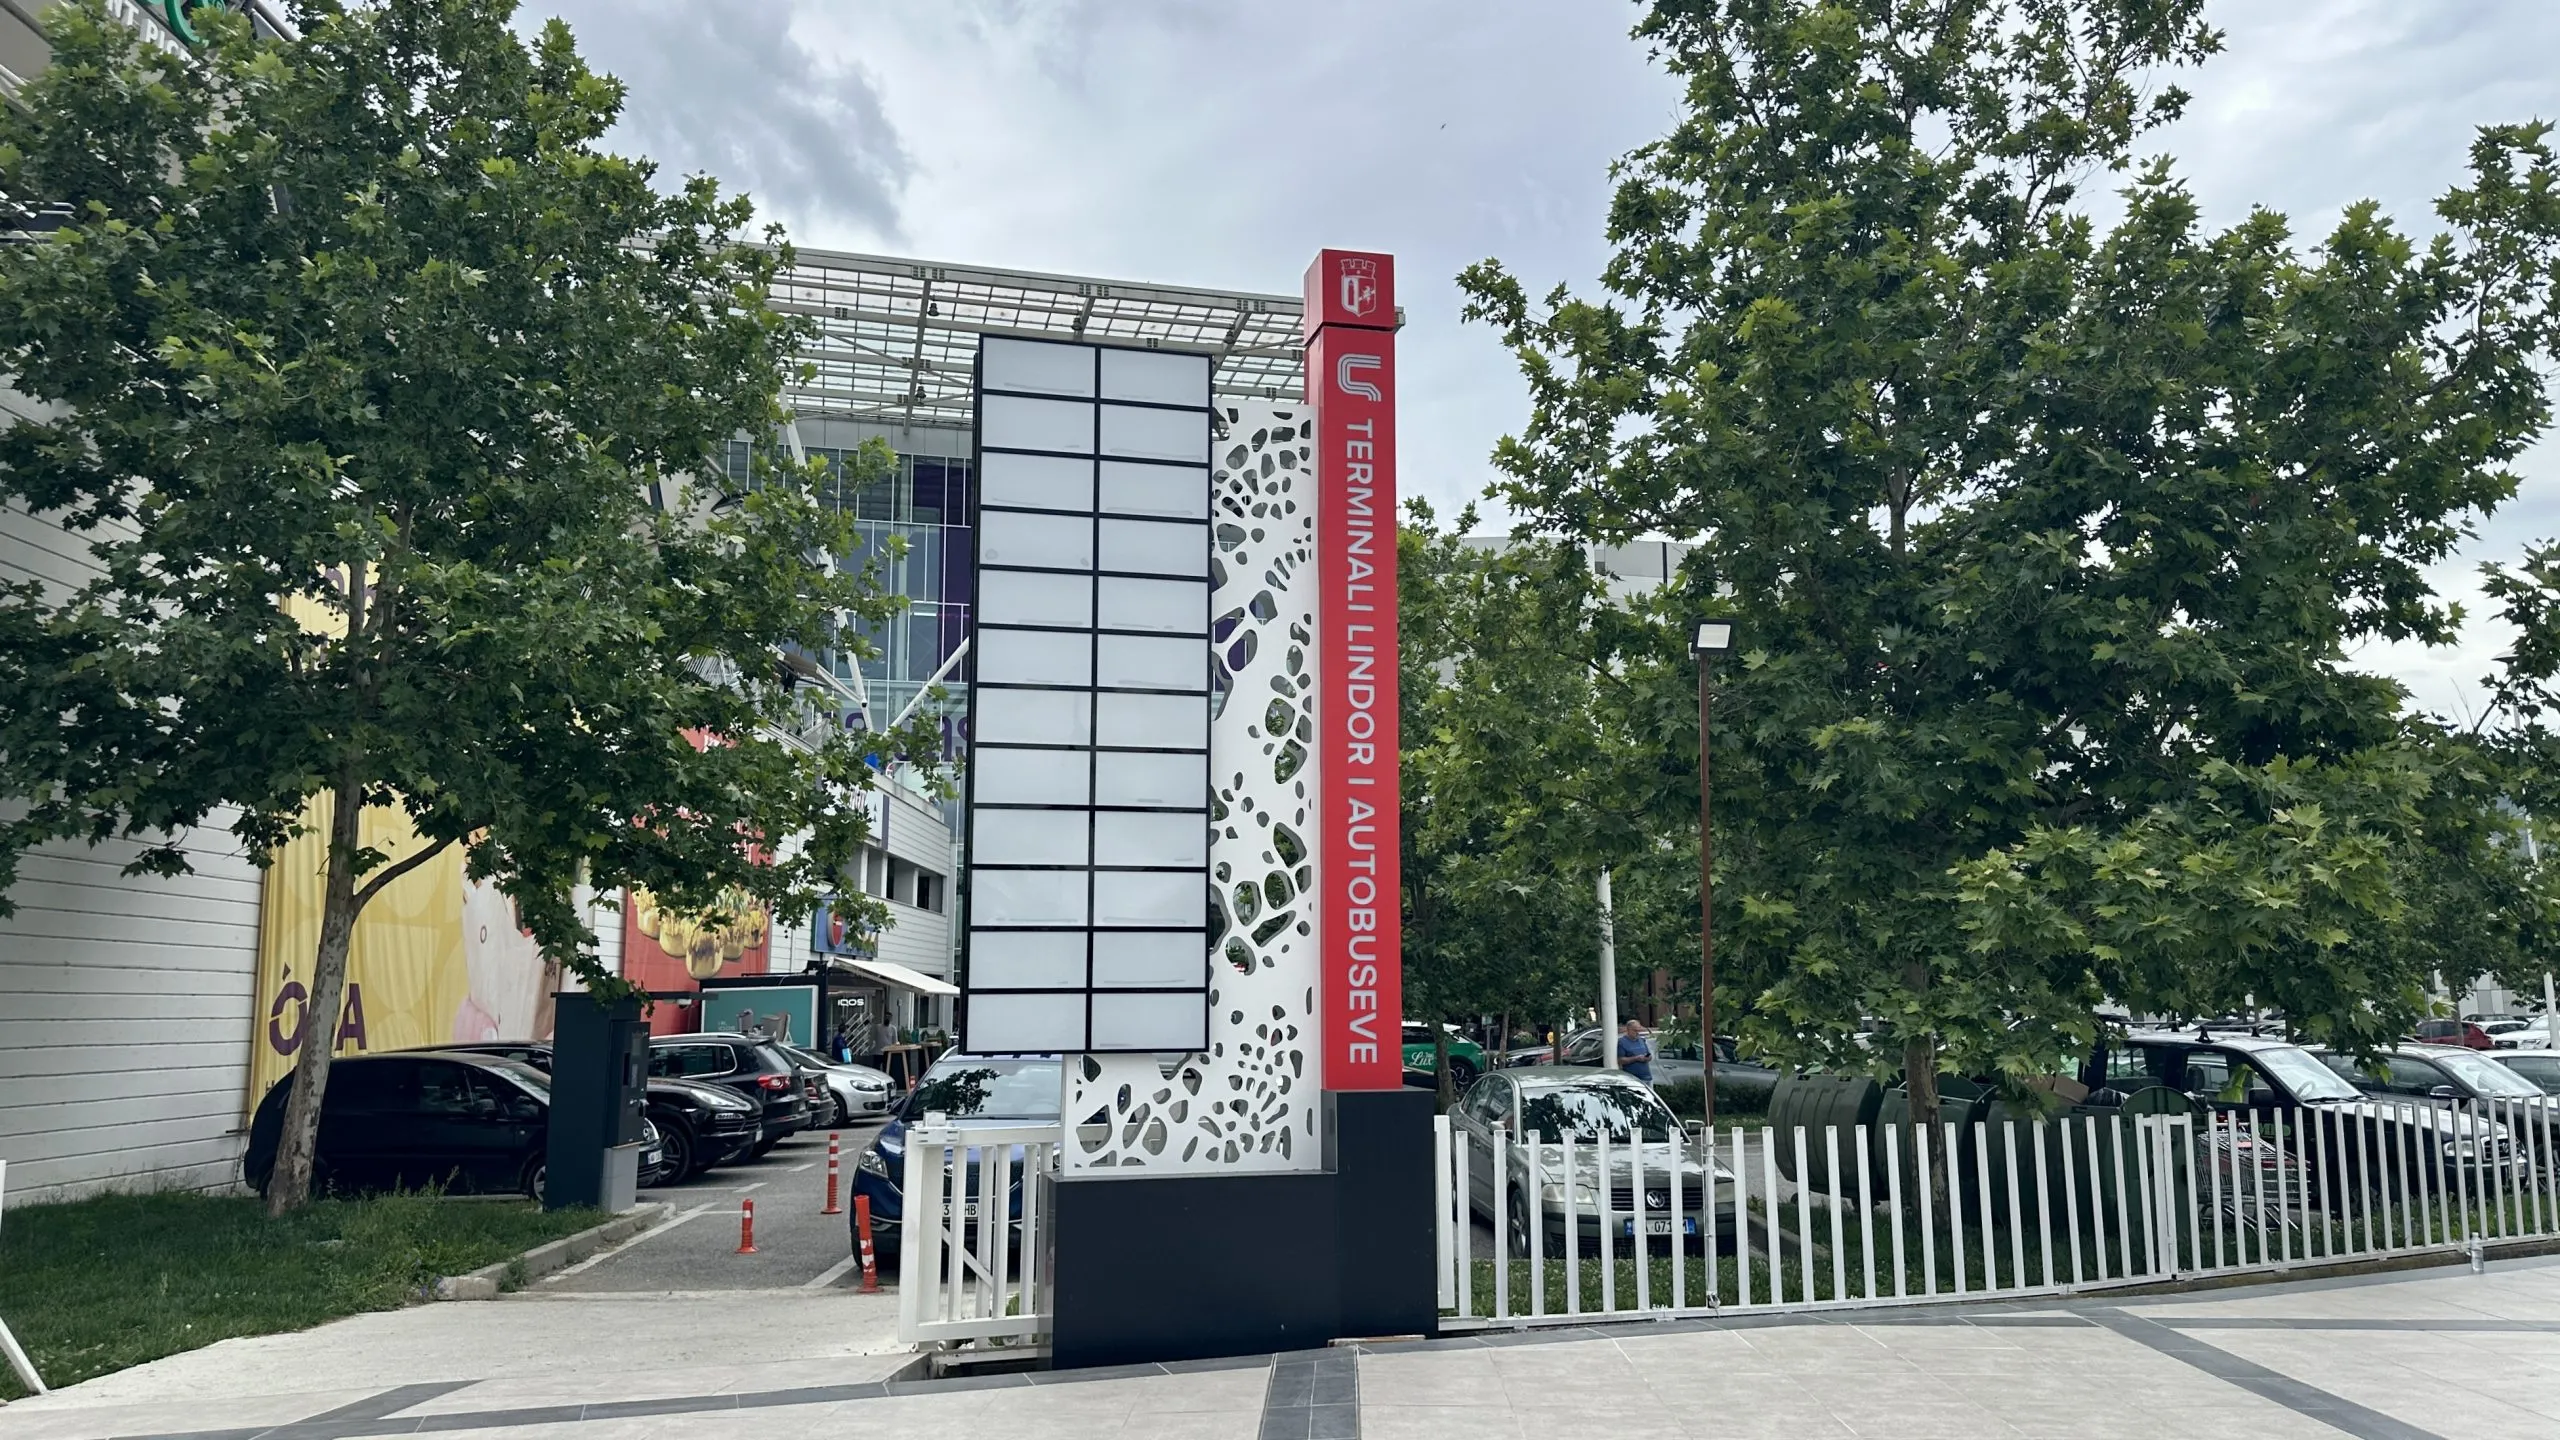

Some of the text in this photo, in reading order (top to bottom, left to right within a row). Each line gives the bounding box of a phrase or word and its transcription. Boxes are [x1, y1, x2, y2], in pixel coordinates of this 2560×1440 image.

[1346, 418, 1378, 1064] TERMINALI LINDOR I AUTOBUSEVE
[837, 998, 865, 1007] IQOS
